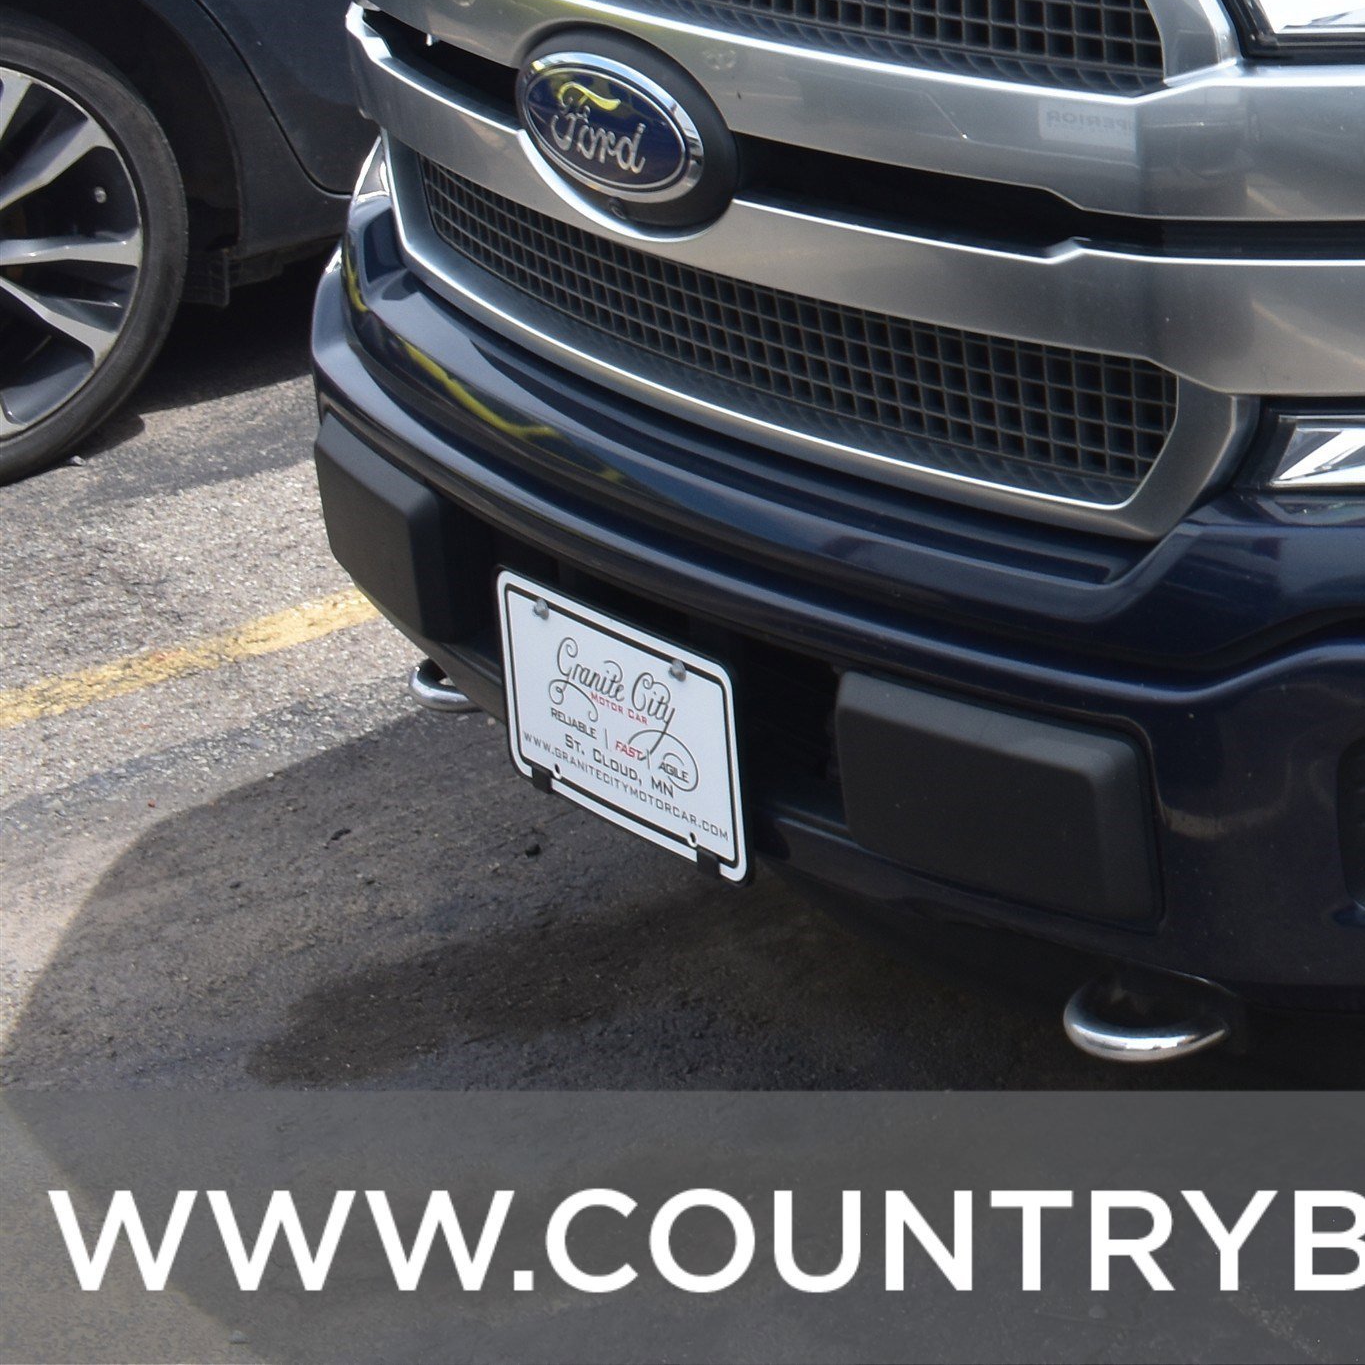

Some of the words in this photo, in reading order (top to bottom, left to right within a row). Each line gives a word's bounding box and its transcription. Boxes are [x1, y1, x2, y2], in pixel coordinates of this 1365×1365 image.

[549, 81, 646, 174] Ford
[550, 637, 626, 707] Granite
[631, 672, 676, 725] City
[591, 692, 624, 715] MOTOR
[627, 707, 648, 725] CAR
[551, 707, 597, 740] RELIABLE
[615, 739, 644, 762] FAST
[658, 760, 691, 784] AGILE
[651, 776, 674, 799] MN
